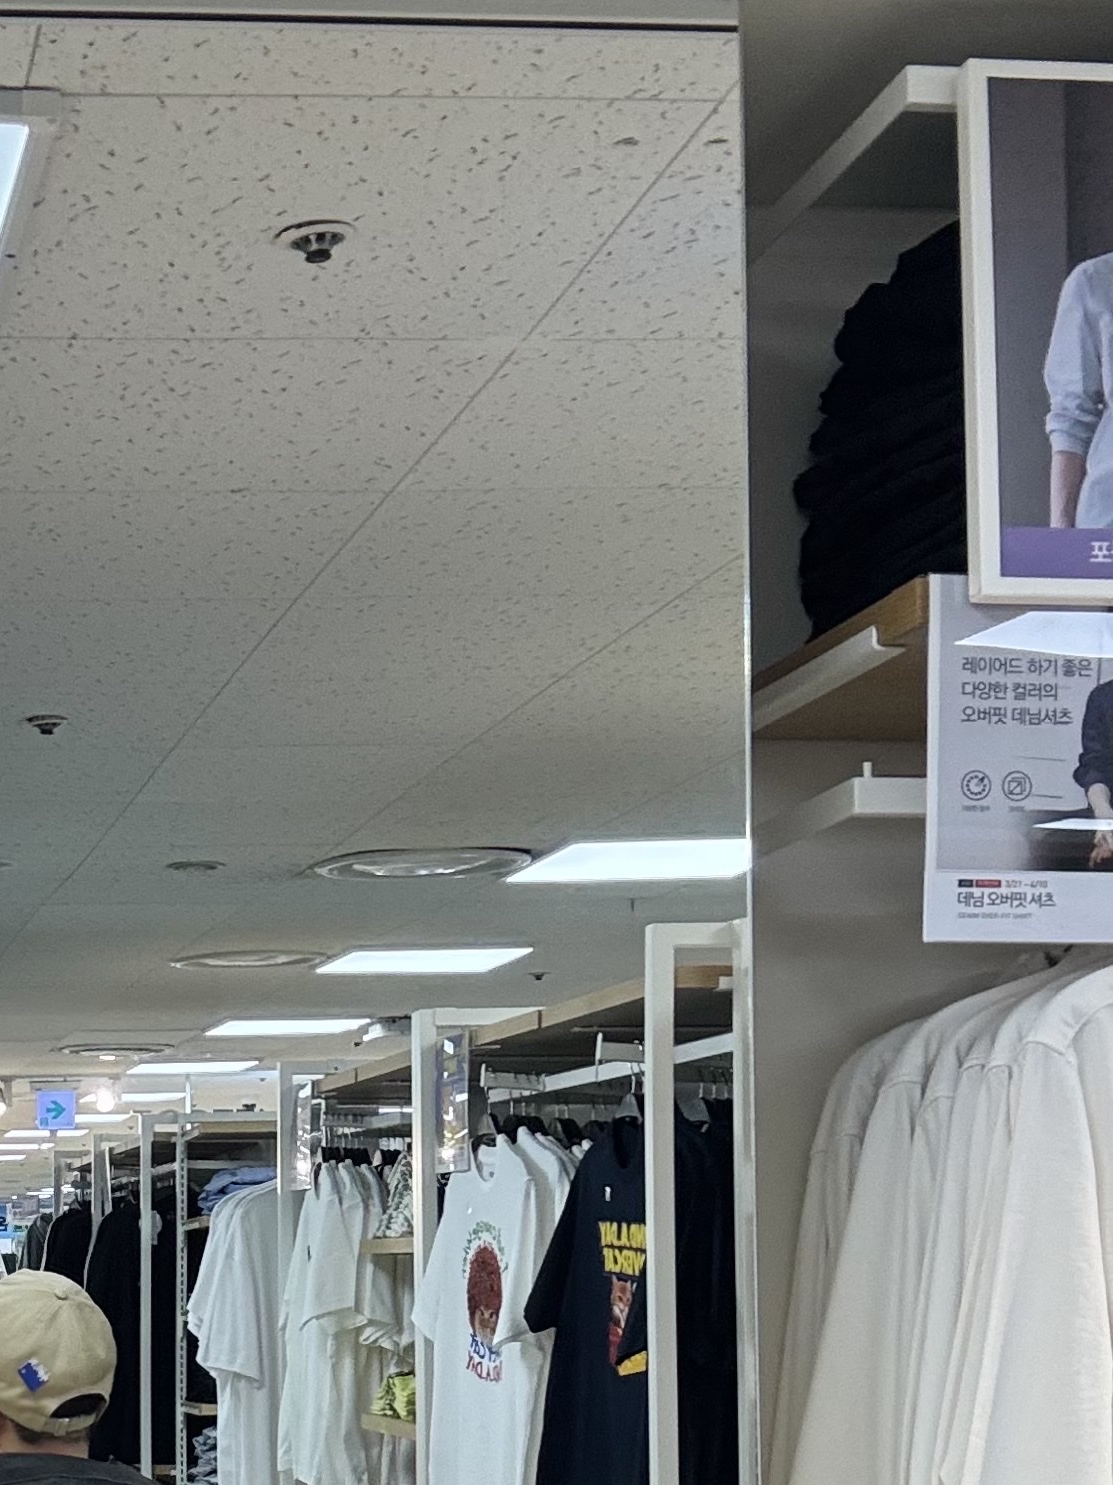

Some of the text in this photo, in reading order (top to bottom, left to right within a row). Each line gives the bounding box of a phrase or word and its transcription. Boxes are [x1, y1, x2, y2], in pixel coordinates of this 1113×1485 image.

[1089, 541, 1113, 562] 포
[961, 656, 1093, 678] 레이어드 하기 좋은
[961, 681, 1058, 702] 다양한 컬러의
[960, 705, 1074, 726] 오버핏 데님셔츠
[957, 891, 1057, 909] 데님 오버핏 셔츠
